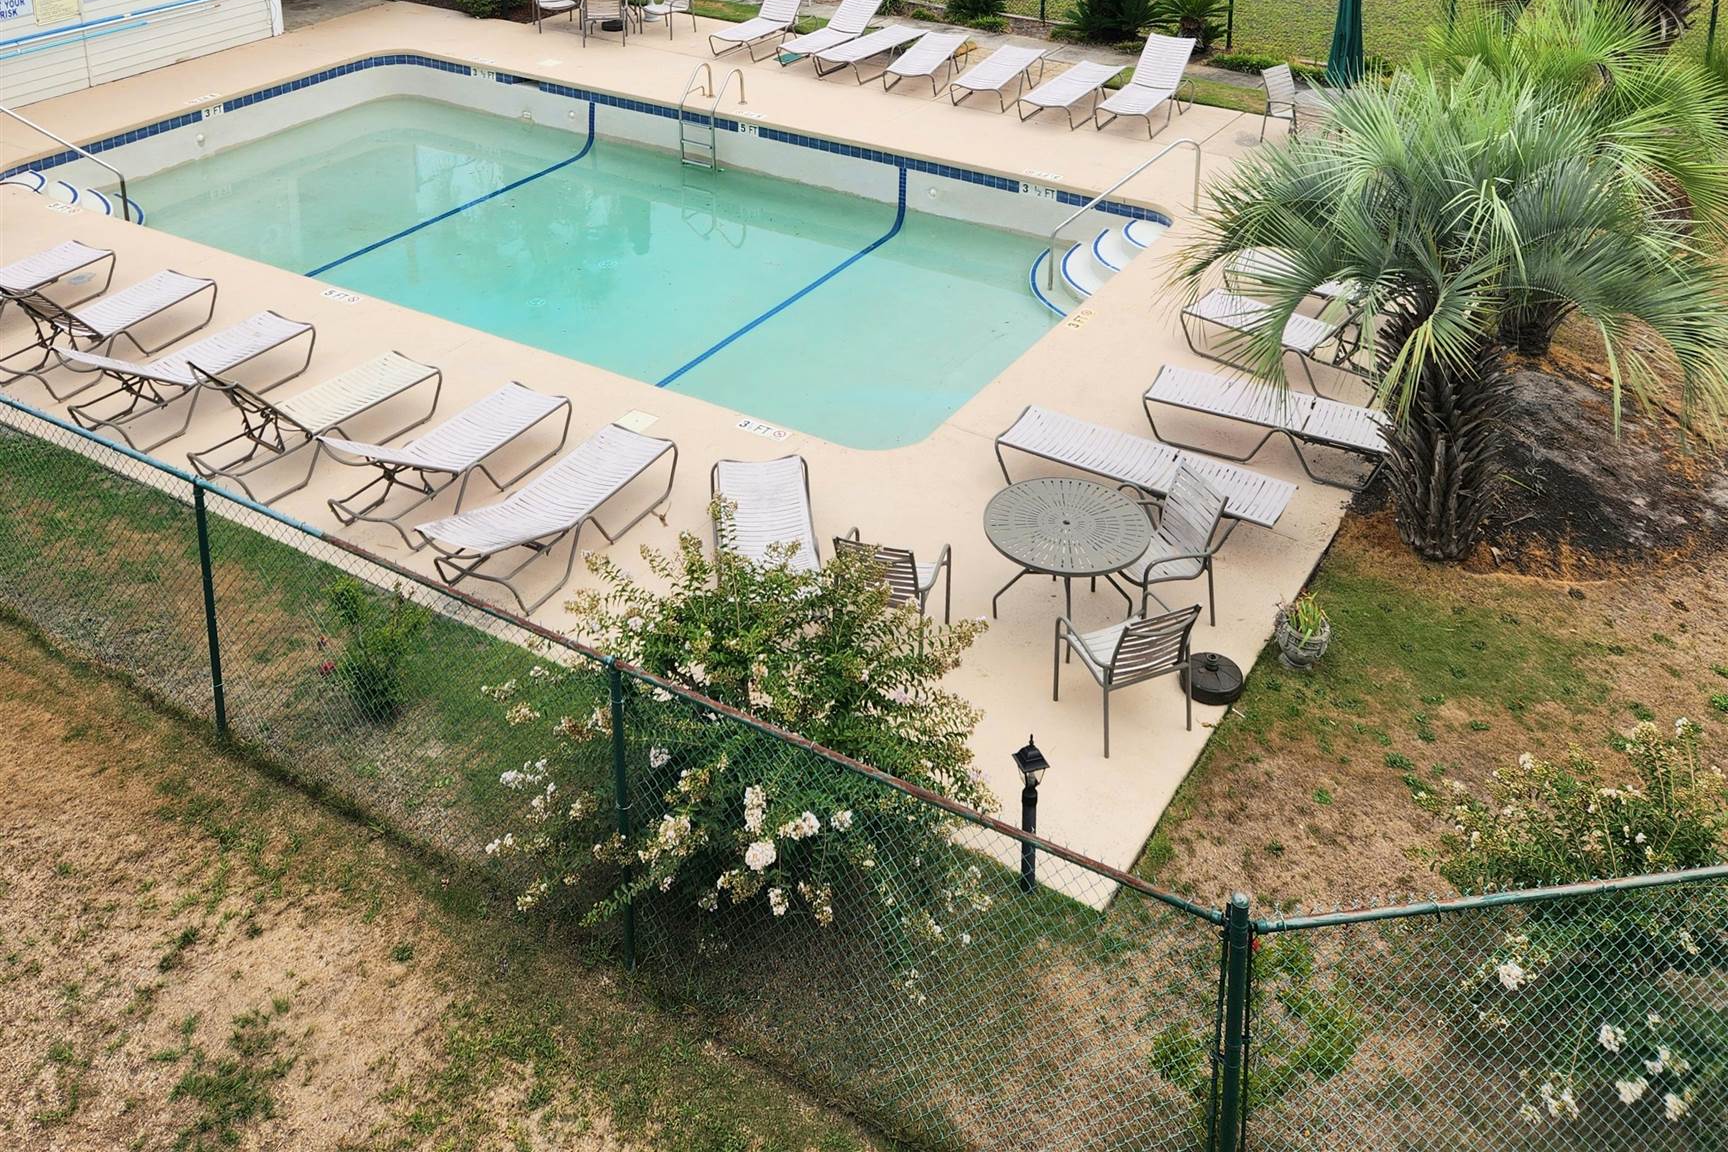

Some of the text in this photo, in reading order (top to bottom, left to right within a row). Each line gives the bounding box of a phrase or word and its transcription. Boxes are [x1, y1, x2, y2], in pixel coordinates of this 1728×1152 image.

[213, 104, 222, 116] FT
[748, 125, 758, 136] FT
[1022, 183, 1029, 193] 3
[1044, 188, 1056, 200] FT
[752, 423, 772, 435] FT
